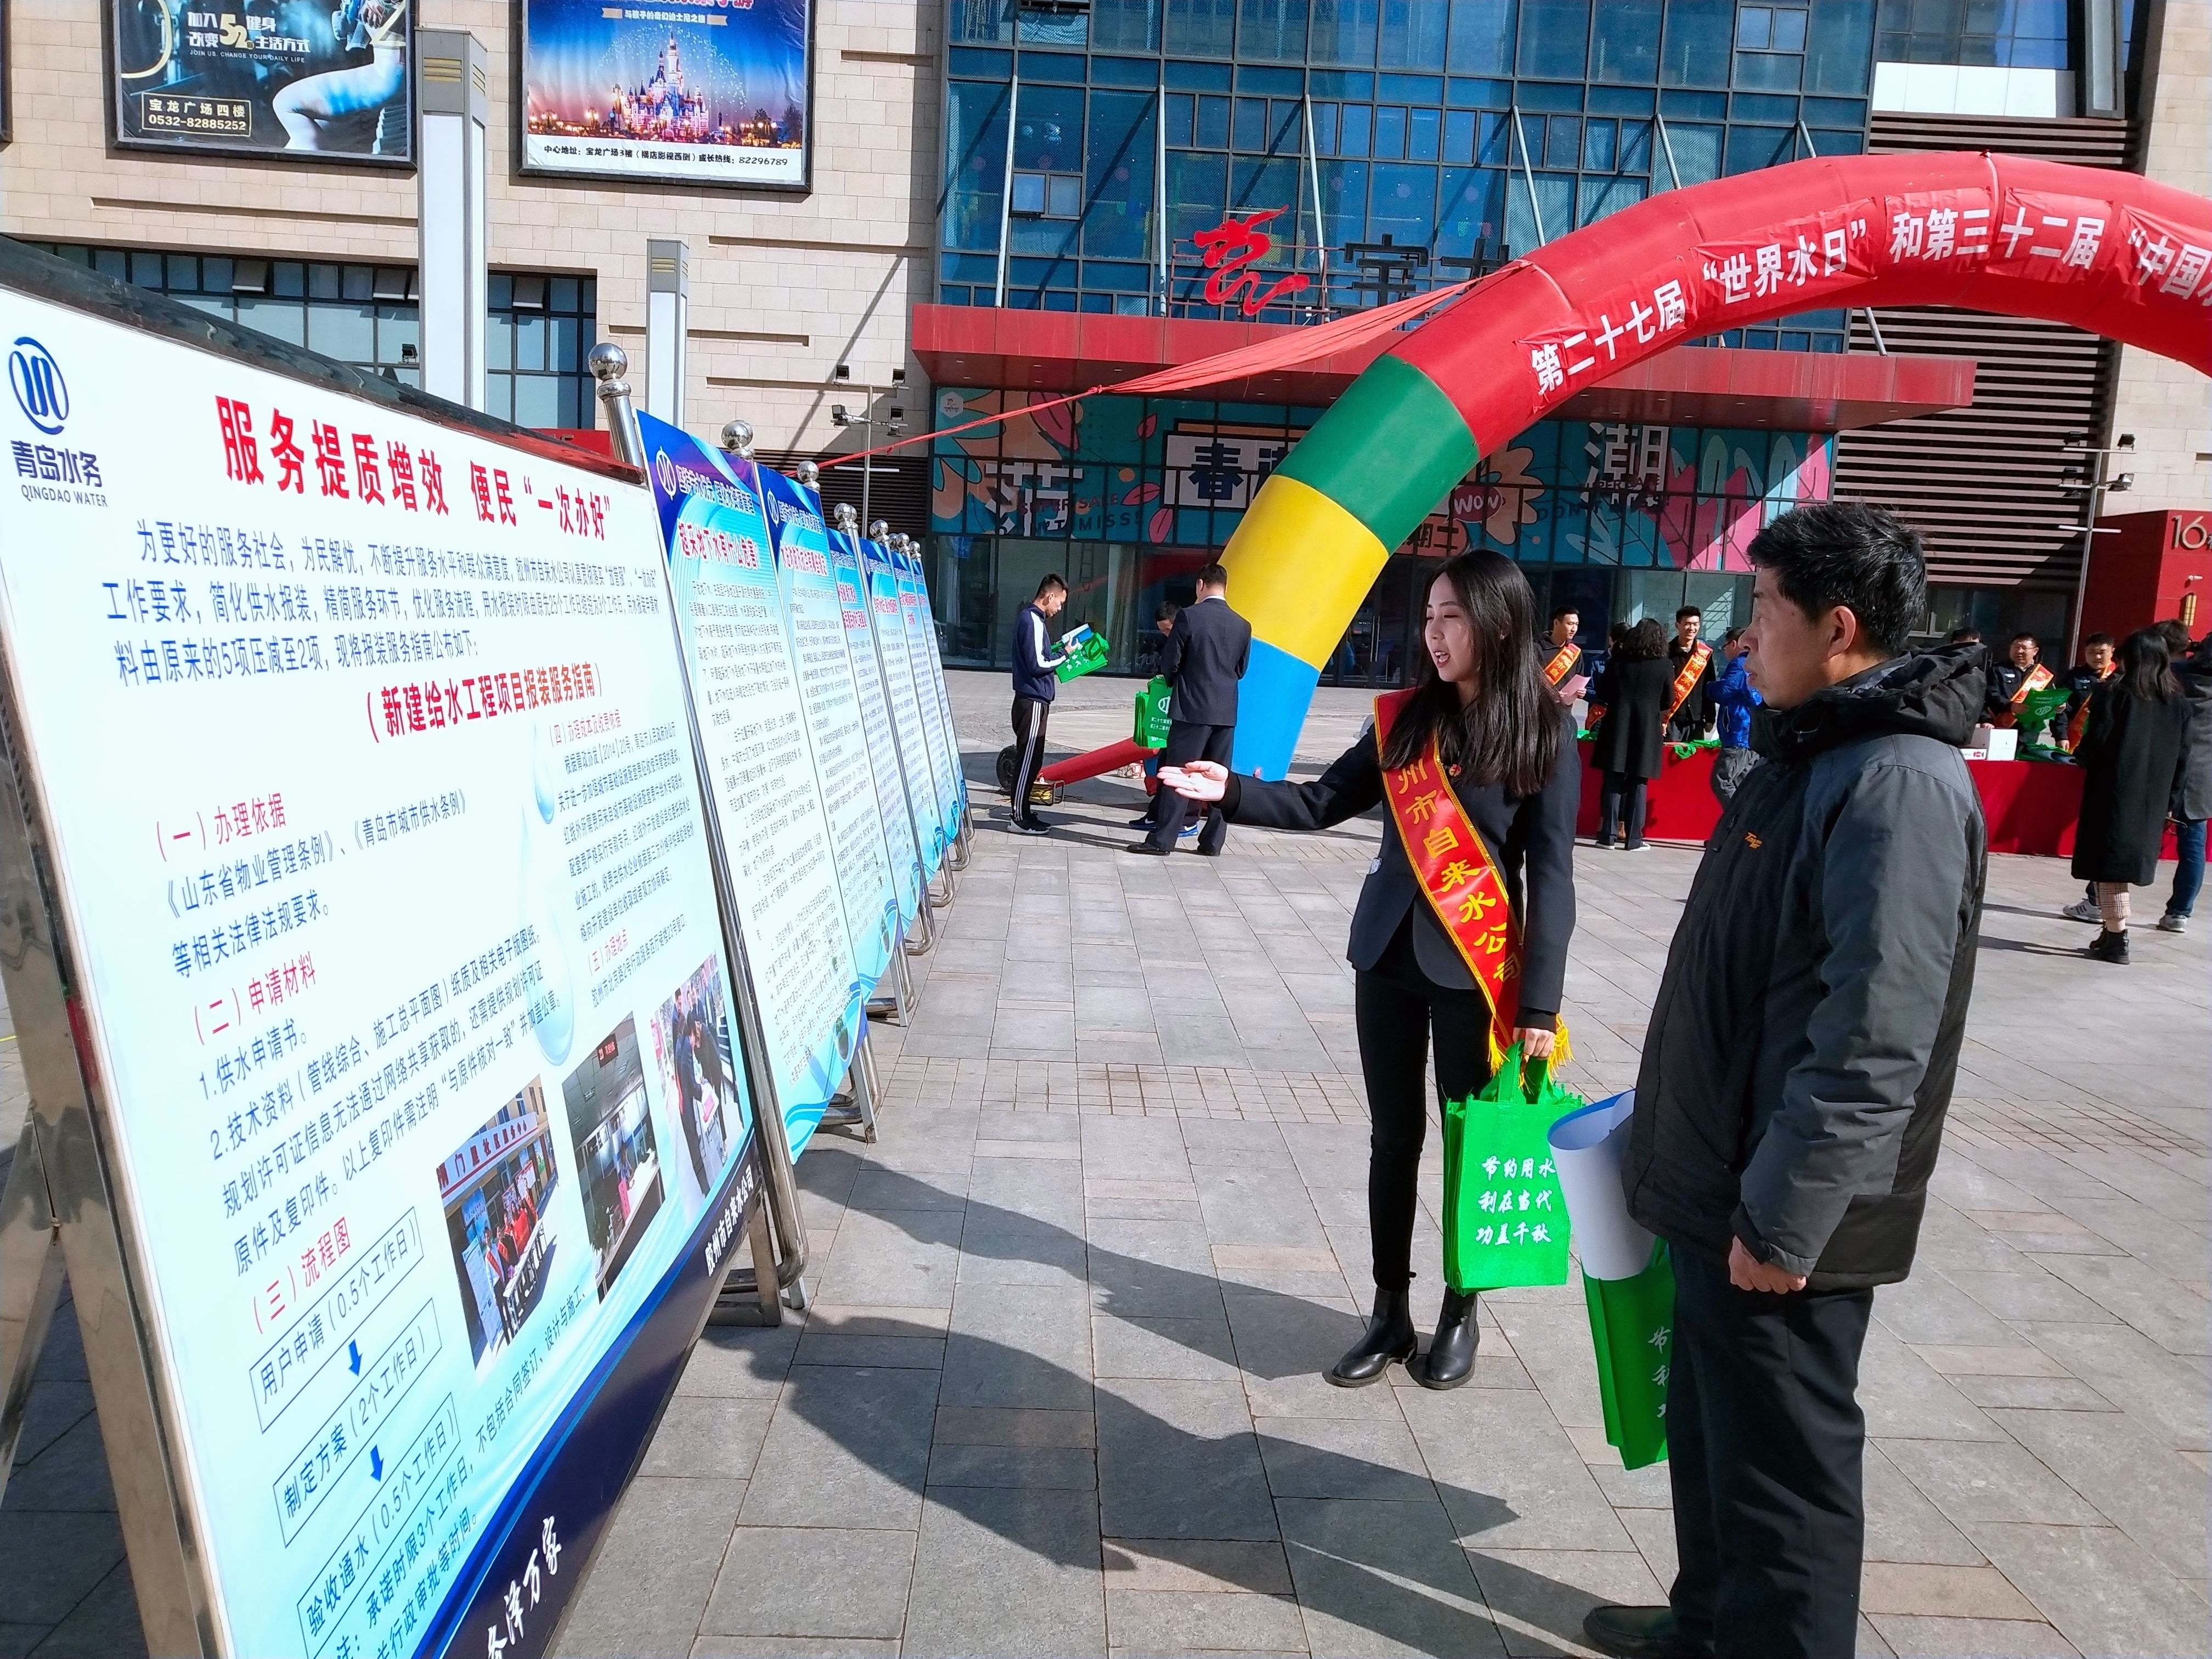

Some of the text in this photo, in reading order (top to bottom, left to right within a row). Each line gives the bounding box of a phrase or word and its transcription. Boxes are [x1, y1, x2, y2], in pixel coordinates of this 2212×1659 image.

[188, 12, 218, 28] 加入
[246, 15, 276, 32] 健身
[189, 31, 218, 48] 改变
[149, 99, 245, 118] 宝龙广场四楼
[149, 114, 246, 131] 0532-82885252
[1531, 279, 1686, 396] 第二十七届
[1889, 207, 2105, 270] 和第三十二届
[10, 439, 103, 488] 青岛水务
[215, 395, 611, 541] 服务提质增效 便民“一次办好”
[21, 484, 108, 507] QINGDAO WATER
[1079, 492, 1119, 509] SALE
[1454, 494, 1499, 515] WOW
[156, 792, 287, 862] （一）办理依据
[1398, 759, 1521, 983] 州市自来水公司
[172, 889, 329, 978] 等相关法律法规要求。
[195, 951, 317, 1046] （二）申请材料
[199, 1018, 307, 1101] 1.供水申请书。
[1482, 1155, 1556, 1181] 节约用水
[705, 1164, 754, 1277] 胶州市自来水公司
[1477, 1189, 1552, 1214] 利在当代
[1476, 1221, 1551, 1246] 功盖千秋
[253, 1216, 351, 1334] （三）流程图
[260, 1218, 416, 1404] 用户申请（0.5个工作日）
[284, 1326, 426, 1519] 制定方案（2个工作日）
